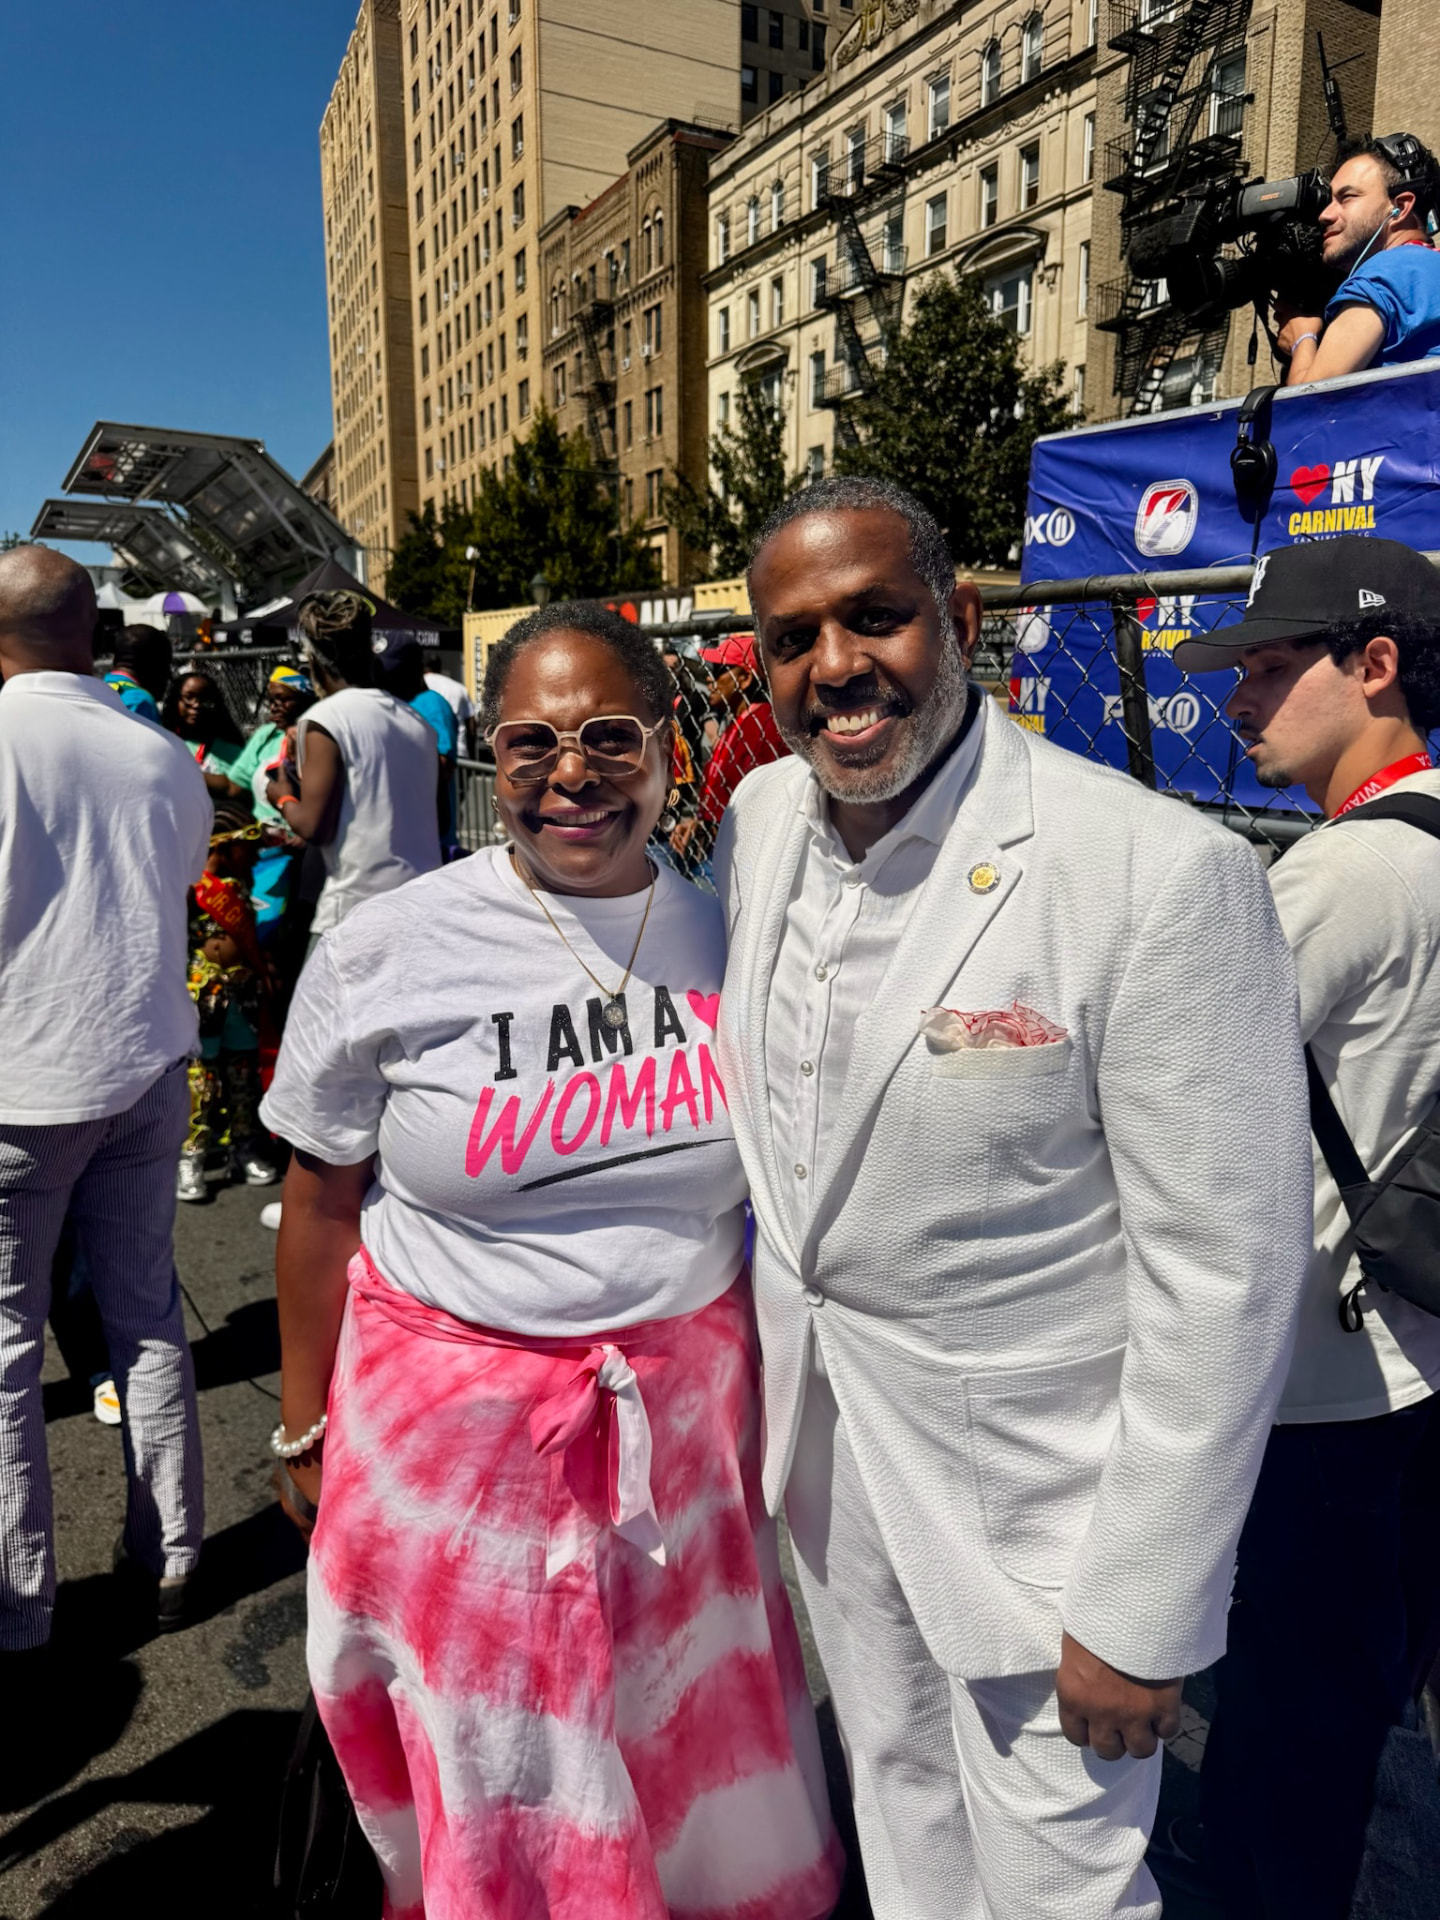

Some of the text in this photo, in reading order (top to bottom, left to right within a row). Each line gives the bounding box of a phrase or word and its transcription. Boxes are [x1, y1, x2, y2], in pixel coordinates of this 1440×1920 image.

[1331, 456, 1385, 504] NY
[1288, 505, 1377, 536] CARNIVAL
[1336, 781, 1382, 818] WIAD
[491, 985, 687, 1082] I AM A
[465, 1043, 730, 1179] WOMAN
